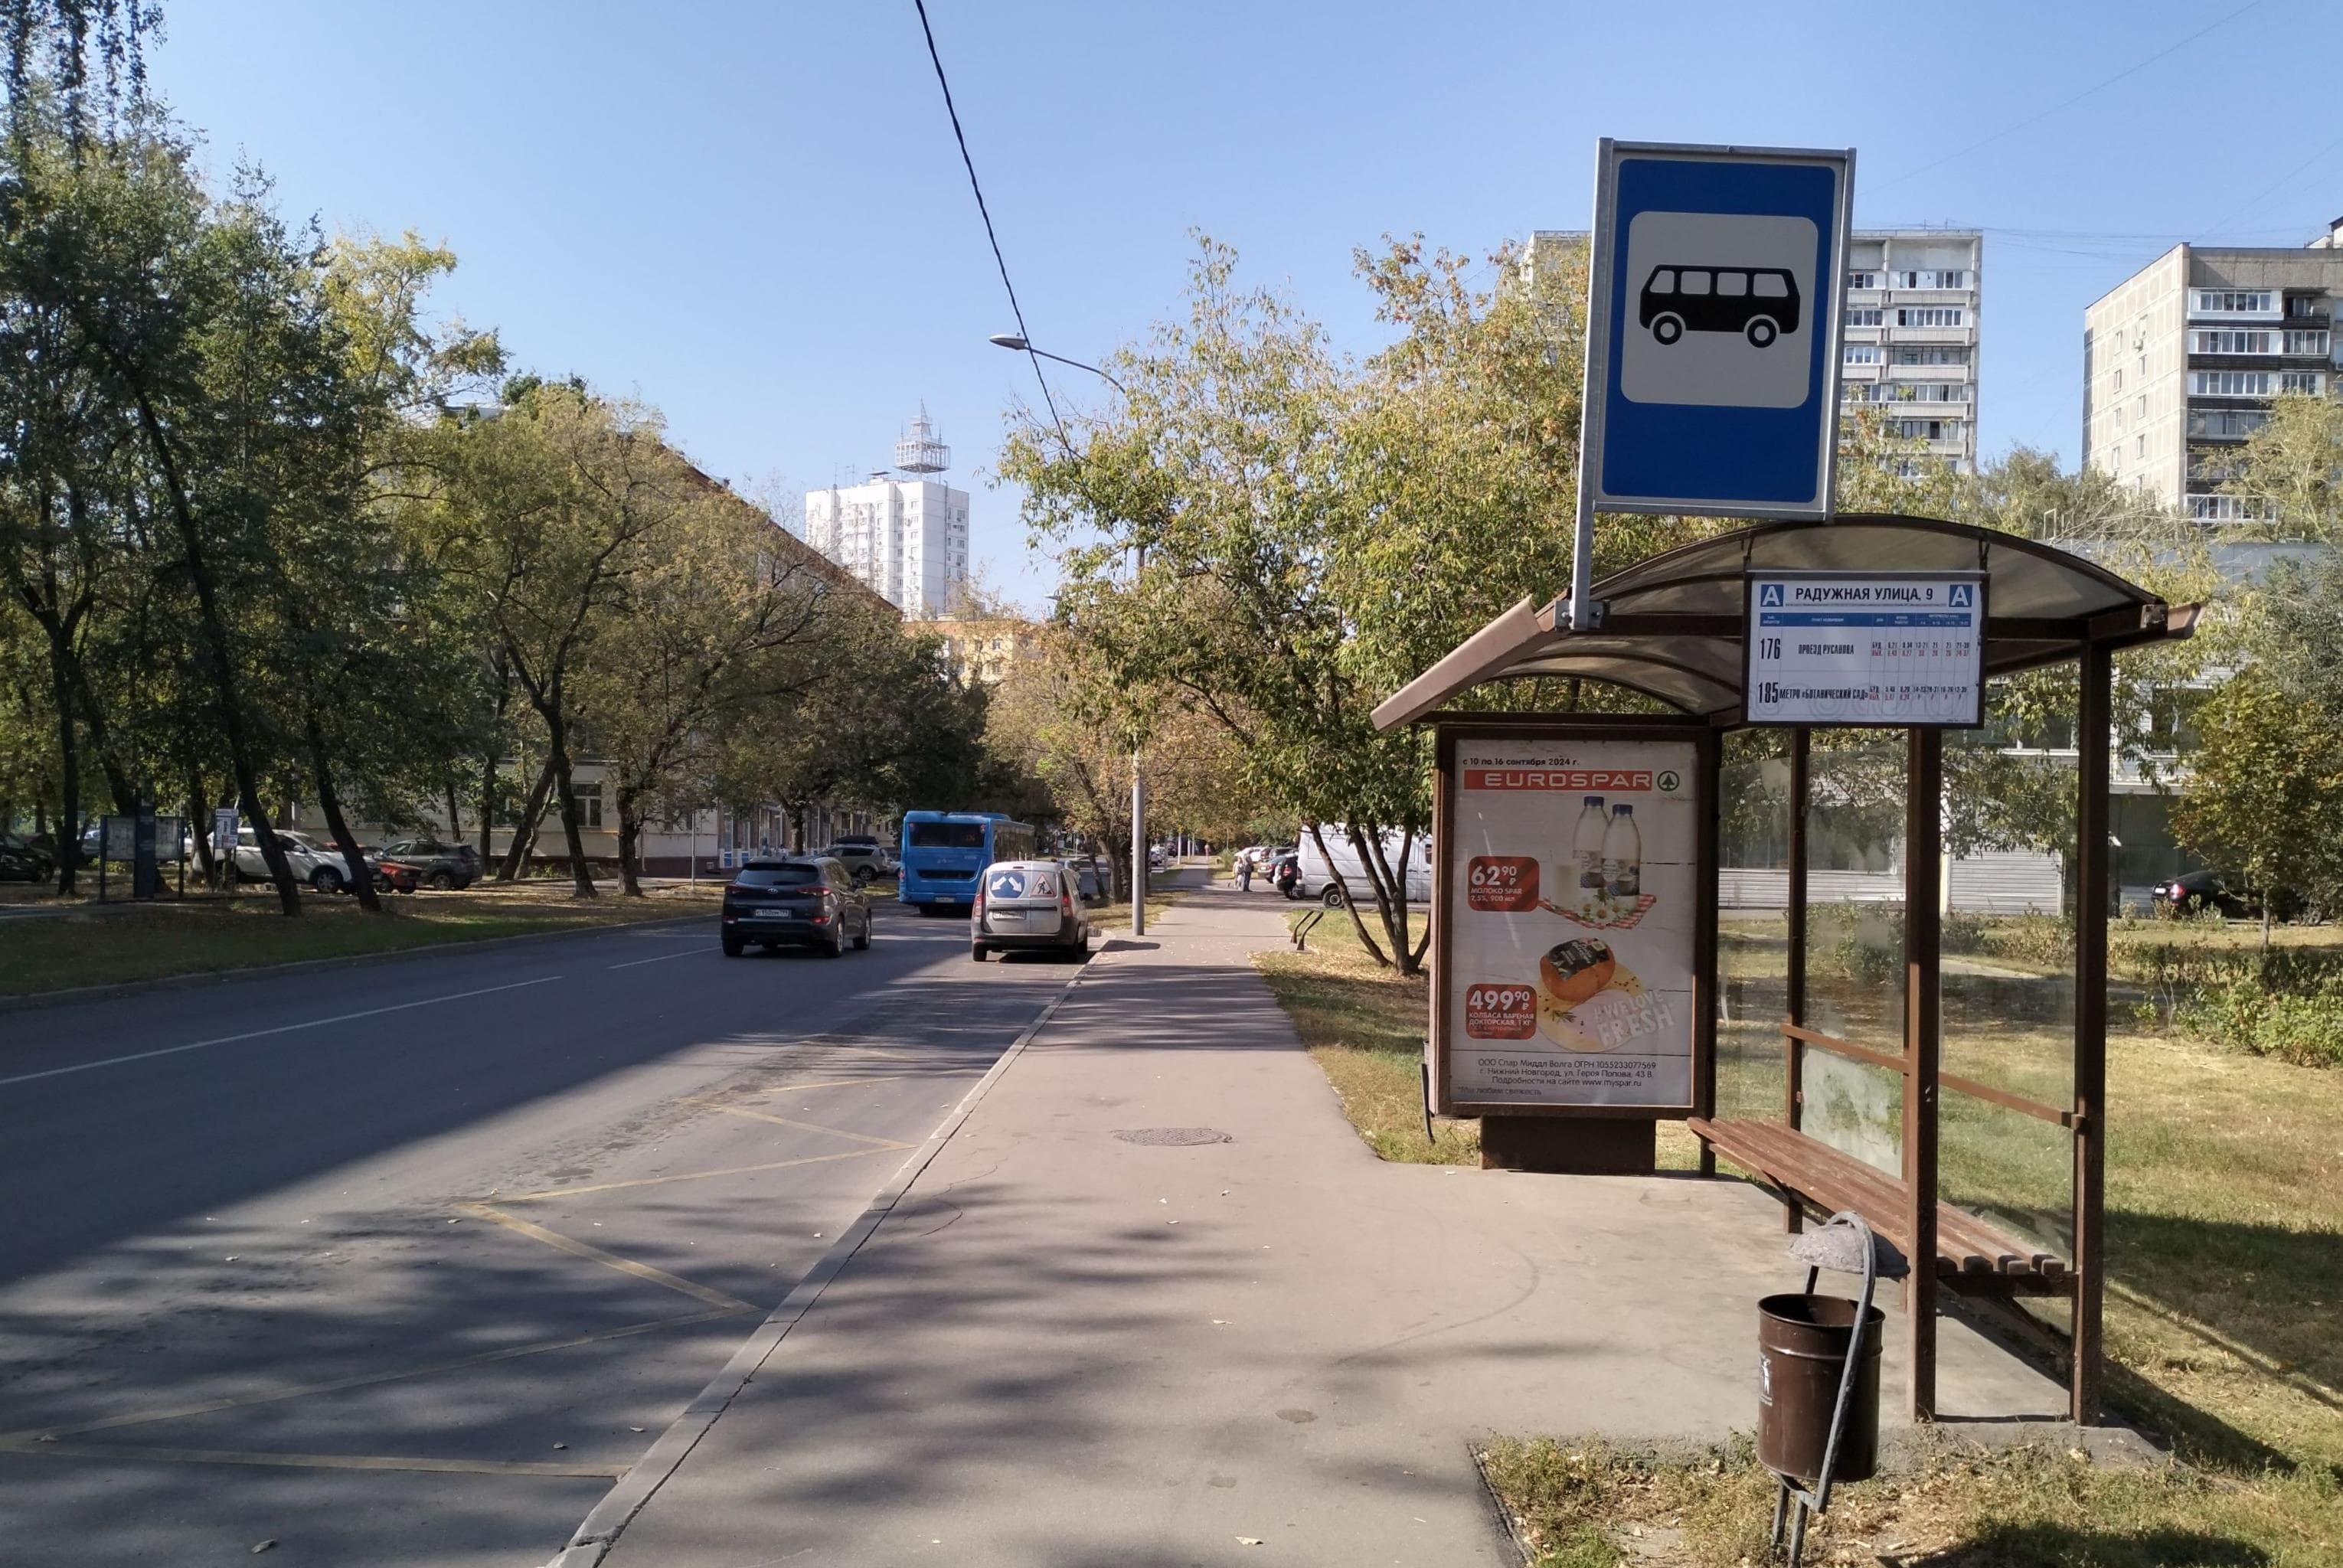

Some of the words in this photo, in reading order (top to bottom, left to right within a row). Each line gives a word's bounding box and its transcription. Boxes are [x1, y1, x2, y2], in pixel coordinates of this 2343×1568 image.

[1796, 587, 1871, 602] РАДУЖНАЯ
[1874, 587, 1921, 602] УЛИЦА,
[1926, 587, 1933, 600] 9
[1760, 638, 1781, 659] 176
[1798, 644, 1822, 655] ПРОЕЗД
[1822, 644, 1854, 655] РУСАНОВА
[1759, 682, 1779, 703] 185
[1779, 688, 1800, 699] МЕТРО
[1802, 688, 1851, 699] «БОТАНИЧЕСКИЙ
[1505, 758, 1546, 766] сентября
[1485, 773, 1650, 787] EUROSPAR
[1629, 989, 1664, 1011] LOVE
[1498, 1059, 1518, 1067] Спар
[1549, 1060, 1572, 1068] Волга
[1577, 1069, 1600, 1077] Героя
[1492, 1076, 1544, 1085] Подробности
